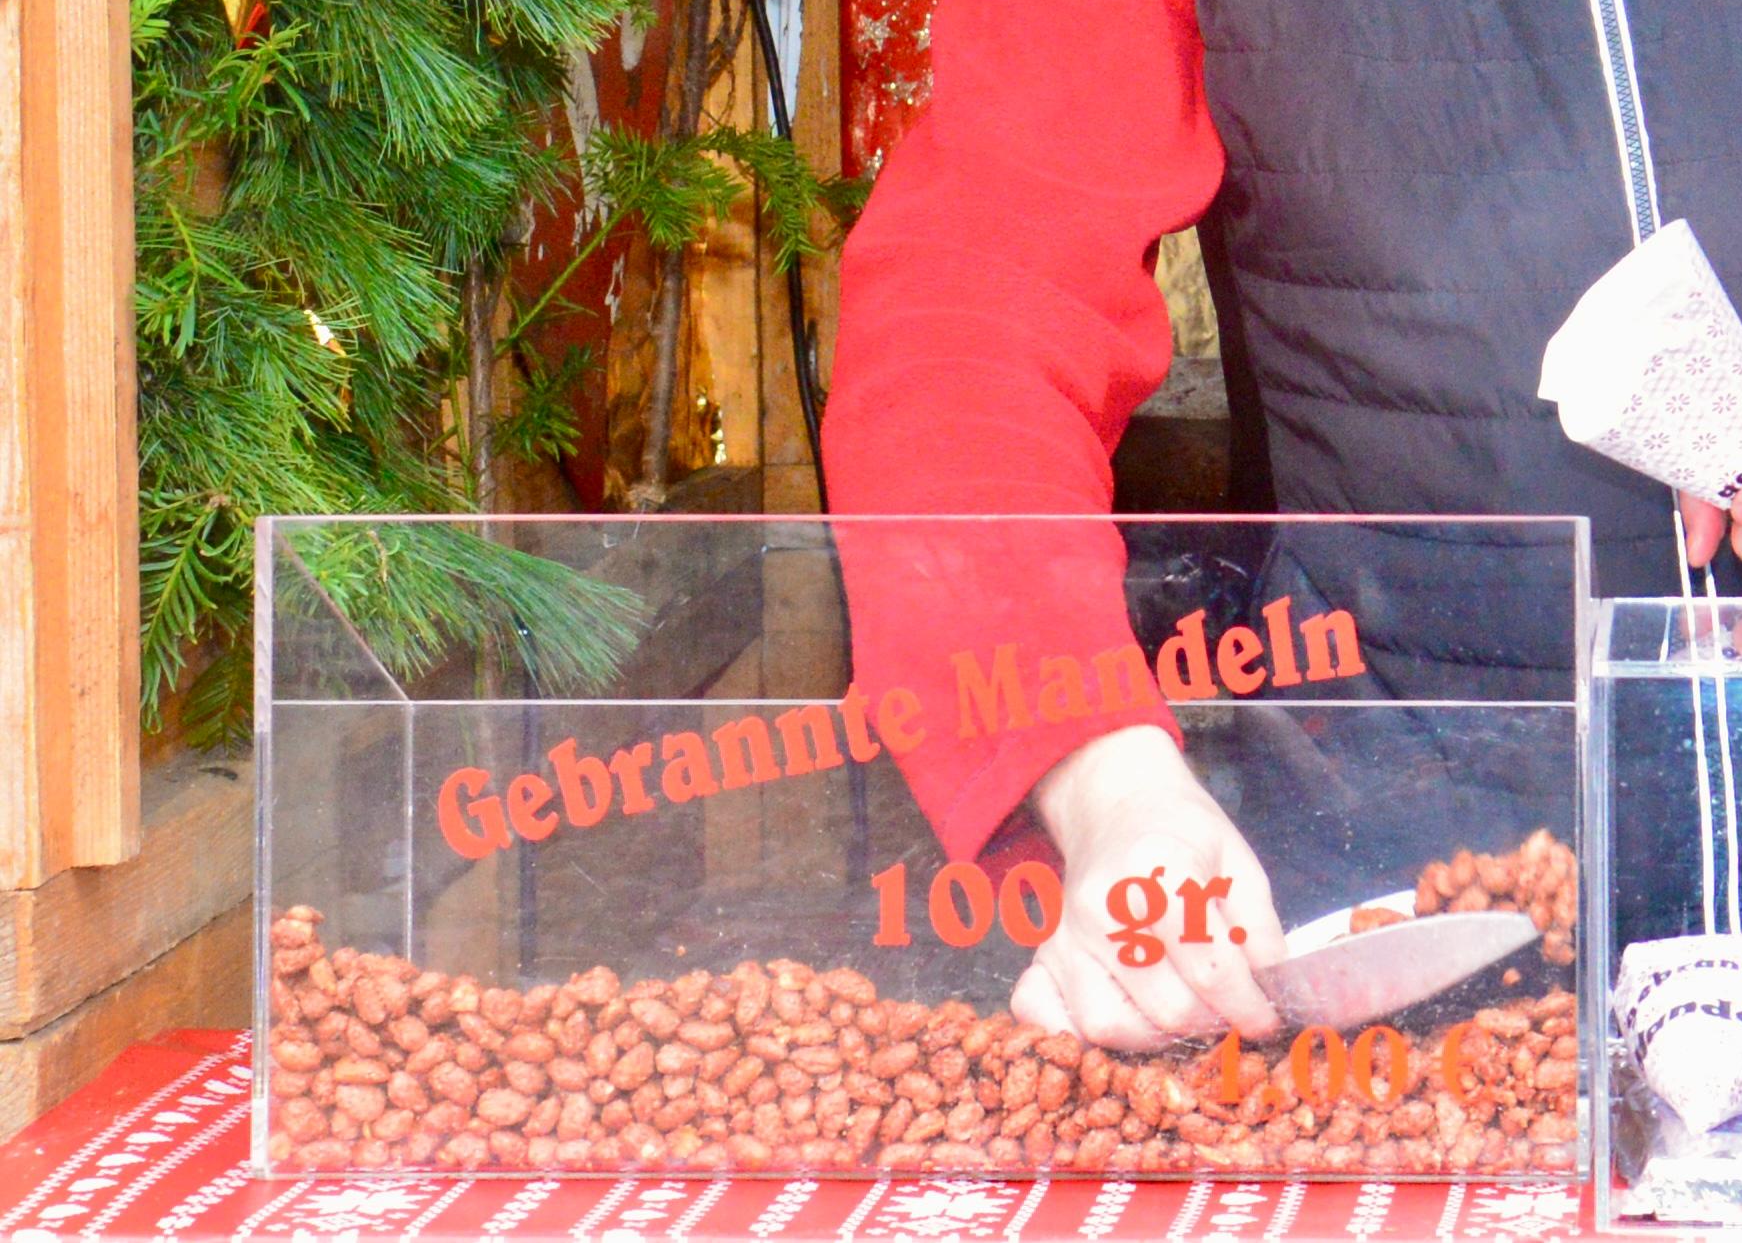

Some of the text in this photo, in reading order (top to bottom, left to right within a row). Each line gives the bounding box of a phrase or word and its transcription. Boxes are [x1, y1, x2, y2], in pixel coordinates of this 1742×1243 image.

[438, 595, 1367, 861] Gebrannte Mandeln
[870, 859, 1249, 967] 100 gr.
